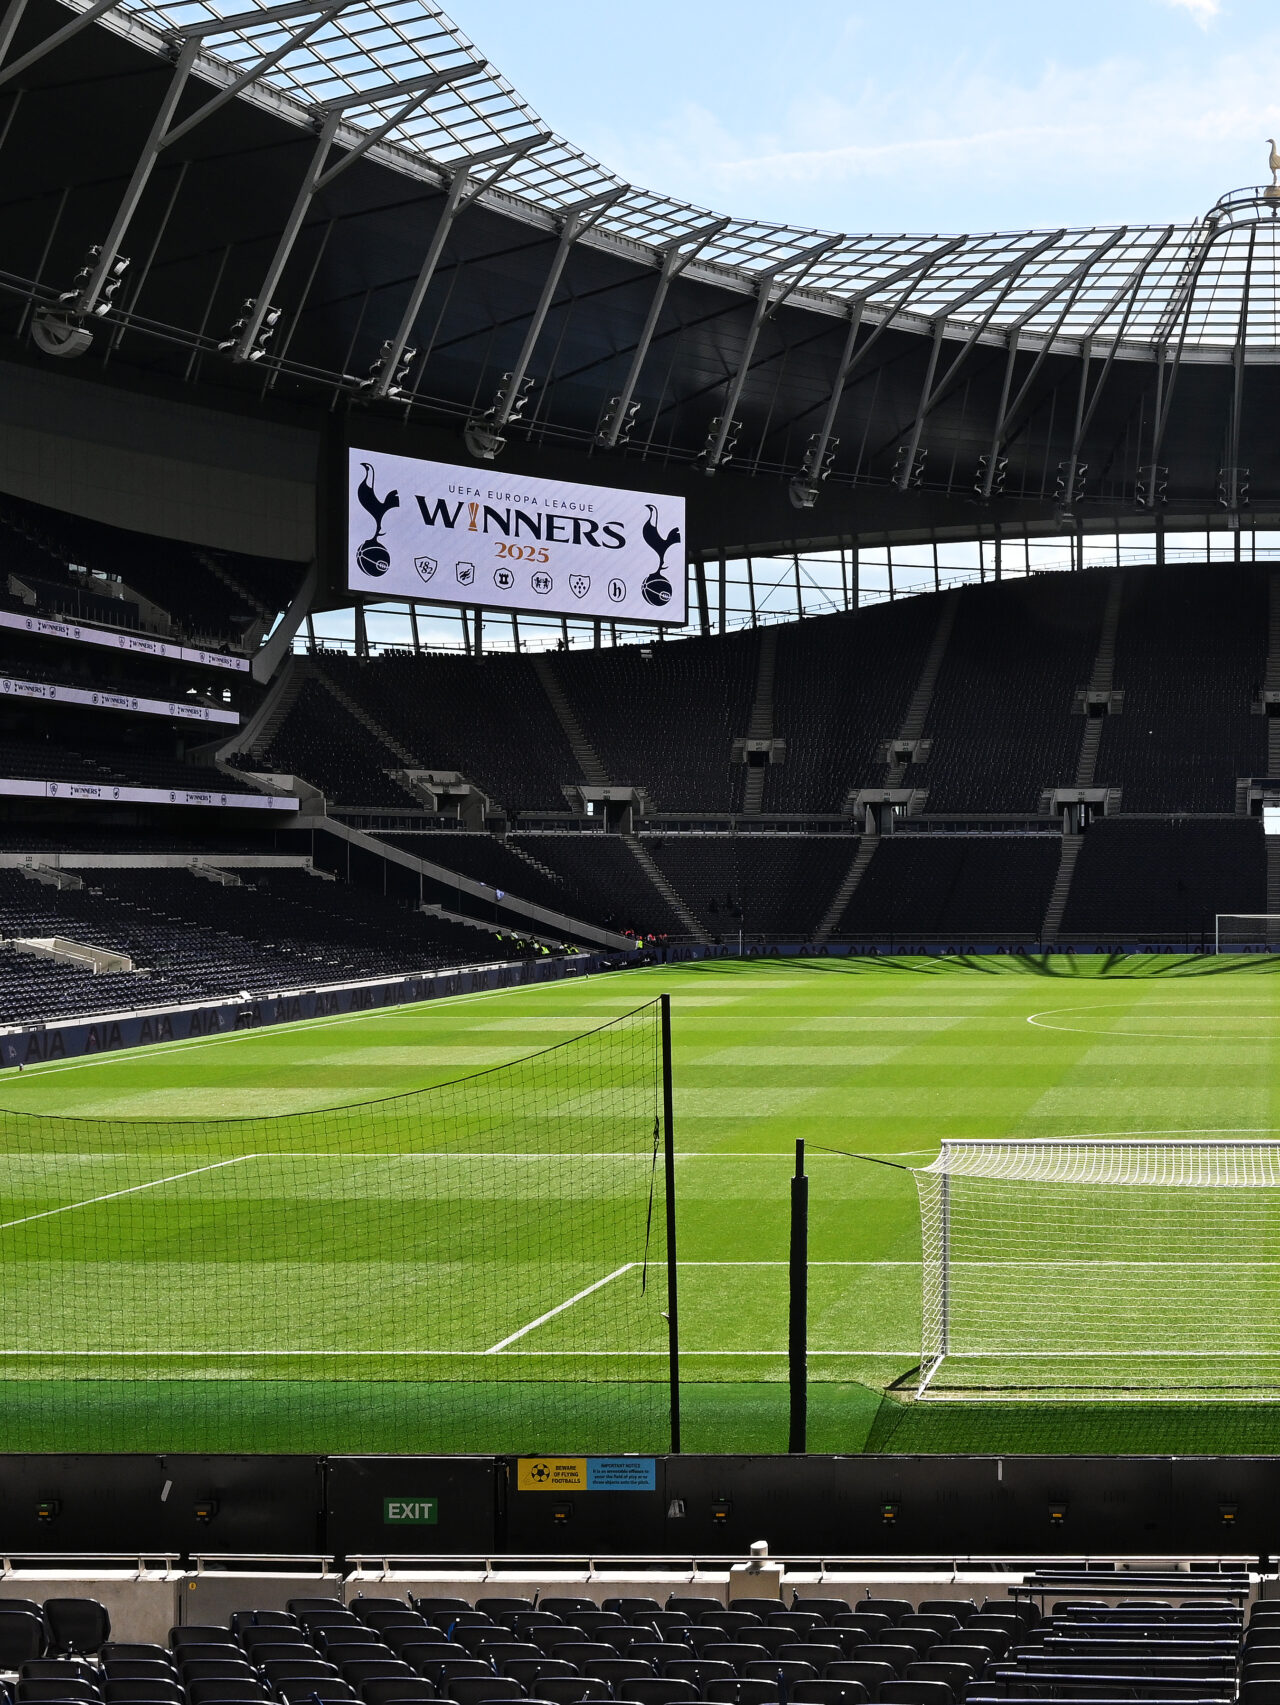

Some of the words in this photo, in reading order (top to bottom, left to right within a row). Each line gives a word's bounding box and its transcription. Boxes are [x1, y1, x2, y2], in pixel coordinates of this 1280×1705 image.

[449, 484, 480, 497] UEFA
[487, 490, 538, 505] EUROPA
[545, 499, 594, 513] LEAGUE
[494, 542, 550, 563] 2025
[26, 1031, 66, 1062] AIA
[190, 1009, 220, 1036] AIA
[388, 1503, 433, 1519] EXIT
